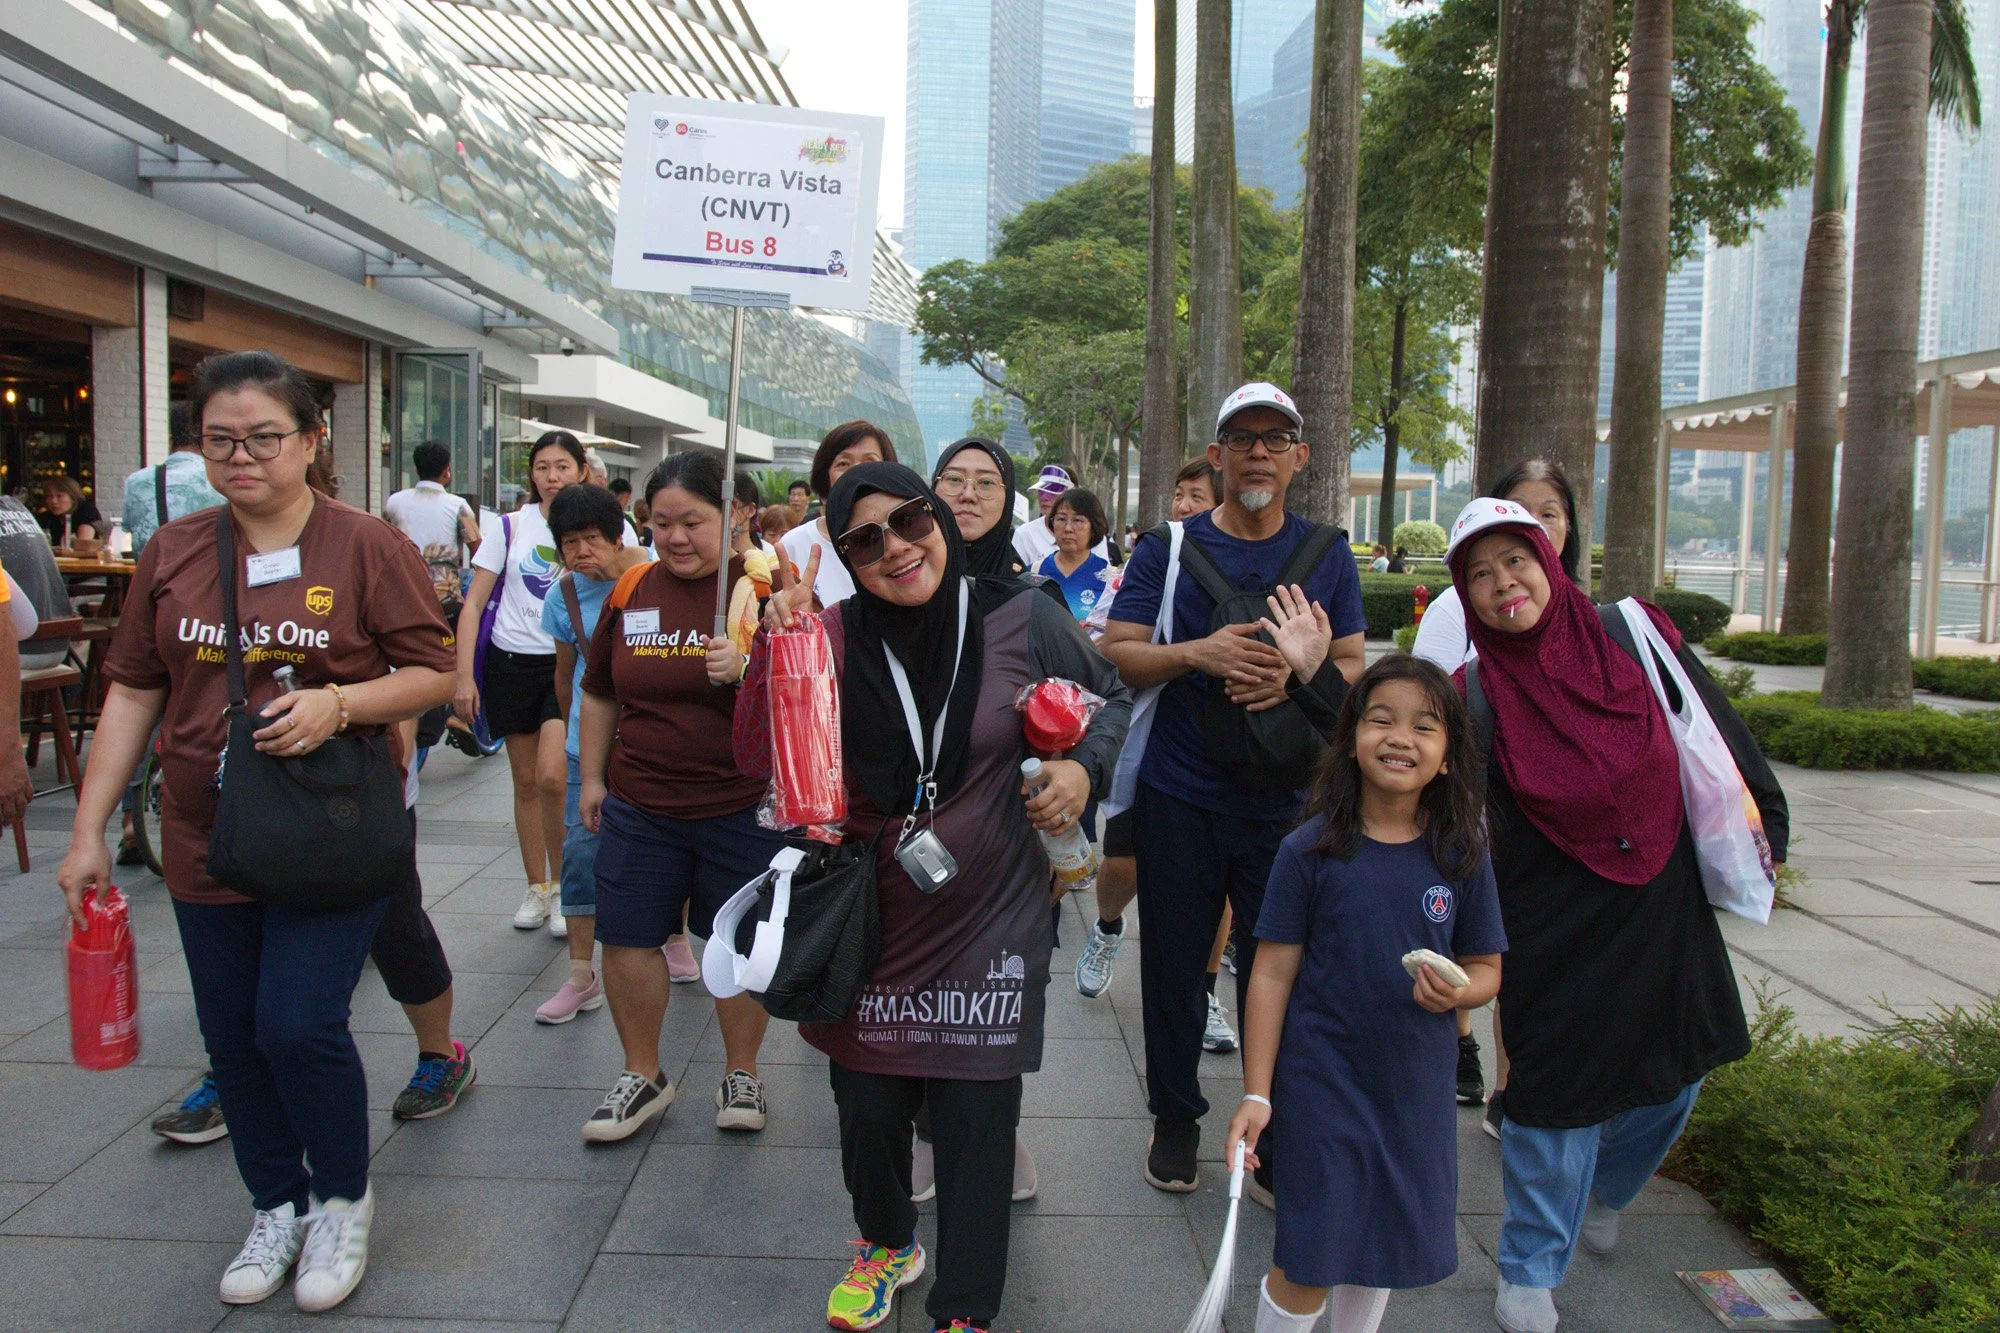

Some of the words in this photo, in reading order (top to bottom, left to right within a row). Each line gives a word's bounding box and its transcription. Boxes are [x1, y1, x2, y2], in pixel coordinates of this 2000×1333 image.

[656, 158, 771, 188] Canberra
[780, 169, 841, 195] Vista
[701, 196, 790, 228] (CNVT)
[706, 231, 754, 255] Bus
[763, 236, 777, 257] 8
[308, 594, 331, 610] ups
[521, 606, 541, 619] Volu
[277, 620, 330, 649] One
[196, 646, 228, 663] Mak
[633, 646, 669, 658] Making
[670, 646, 679, 656] A
[1428, 887, 1450, 898] PARIS
[856, 991, 1022, 1025] #MASJIDKITA
[858, 1030, 898, 1042] KHIDMAT
